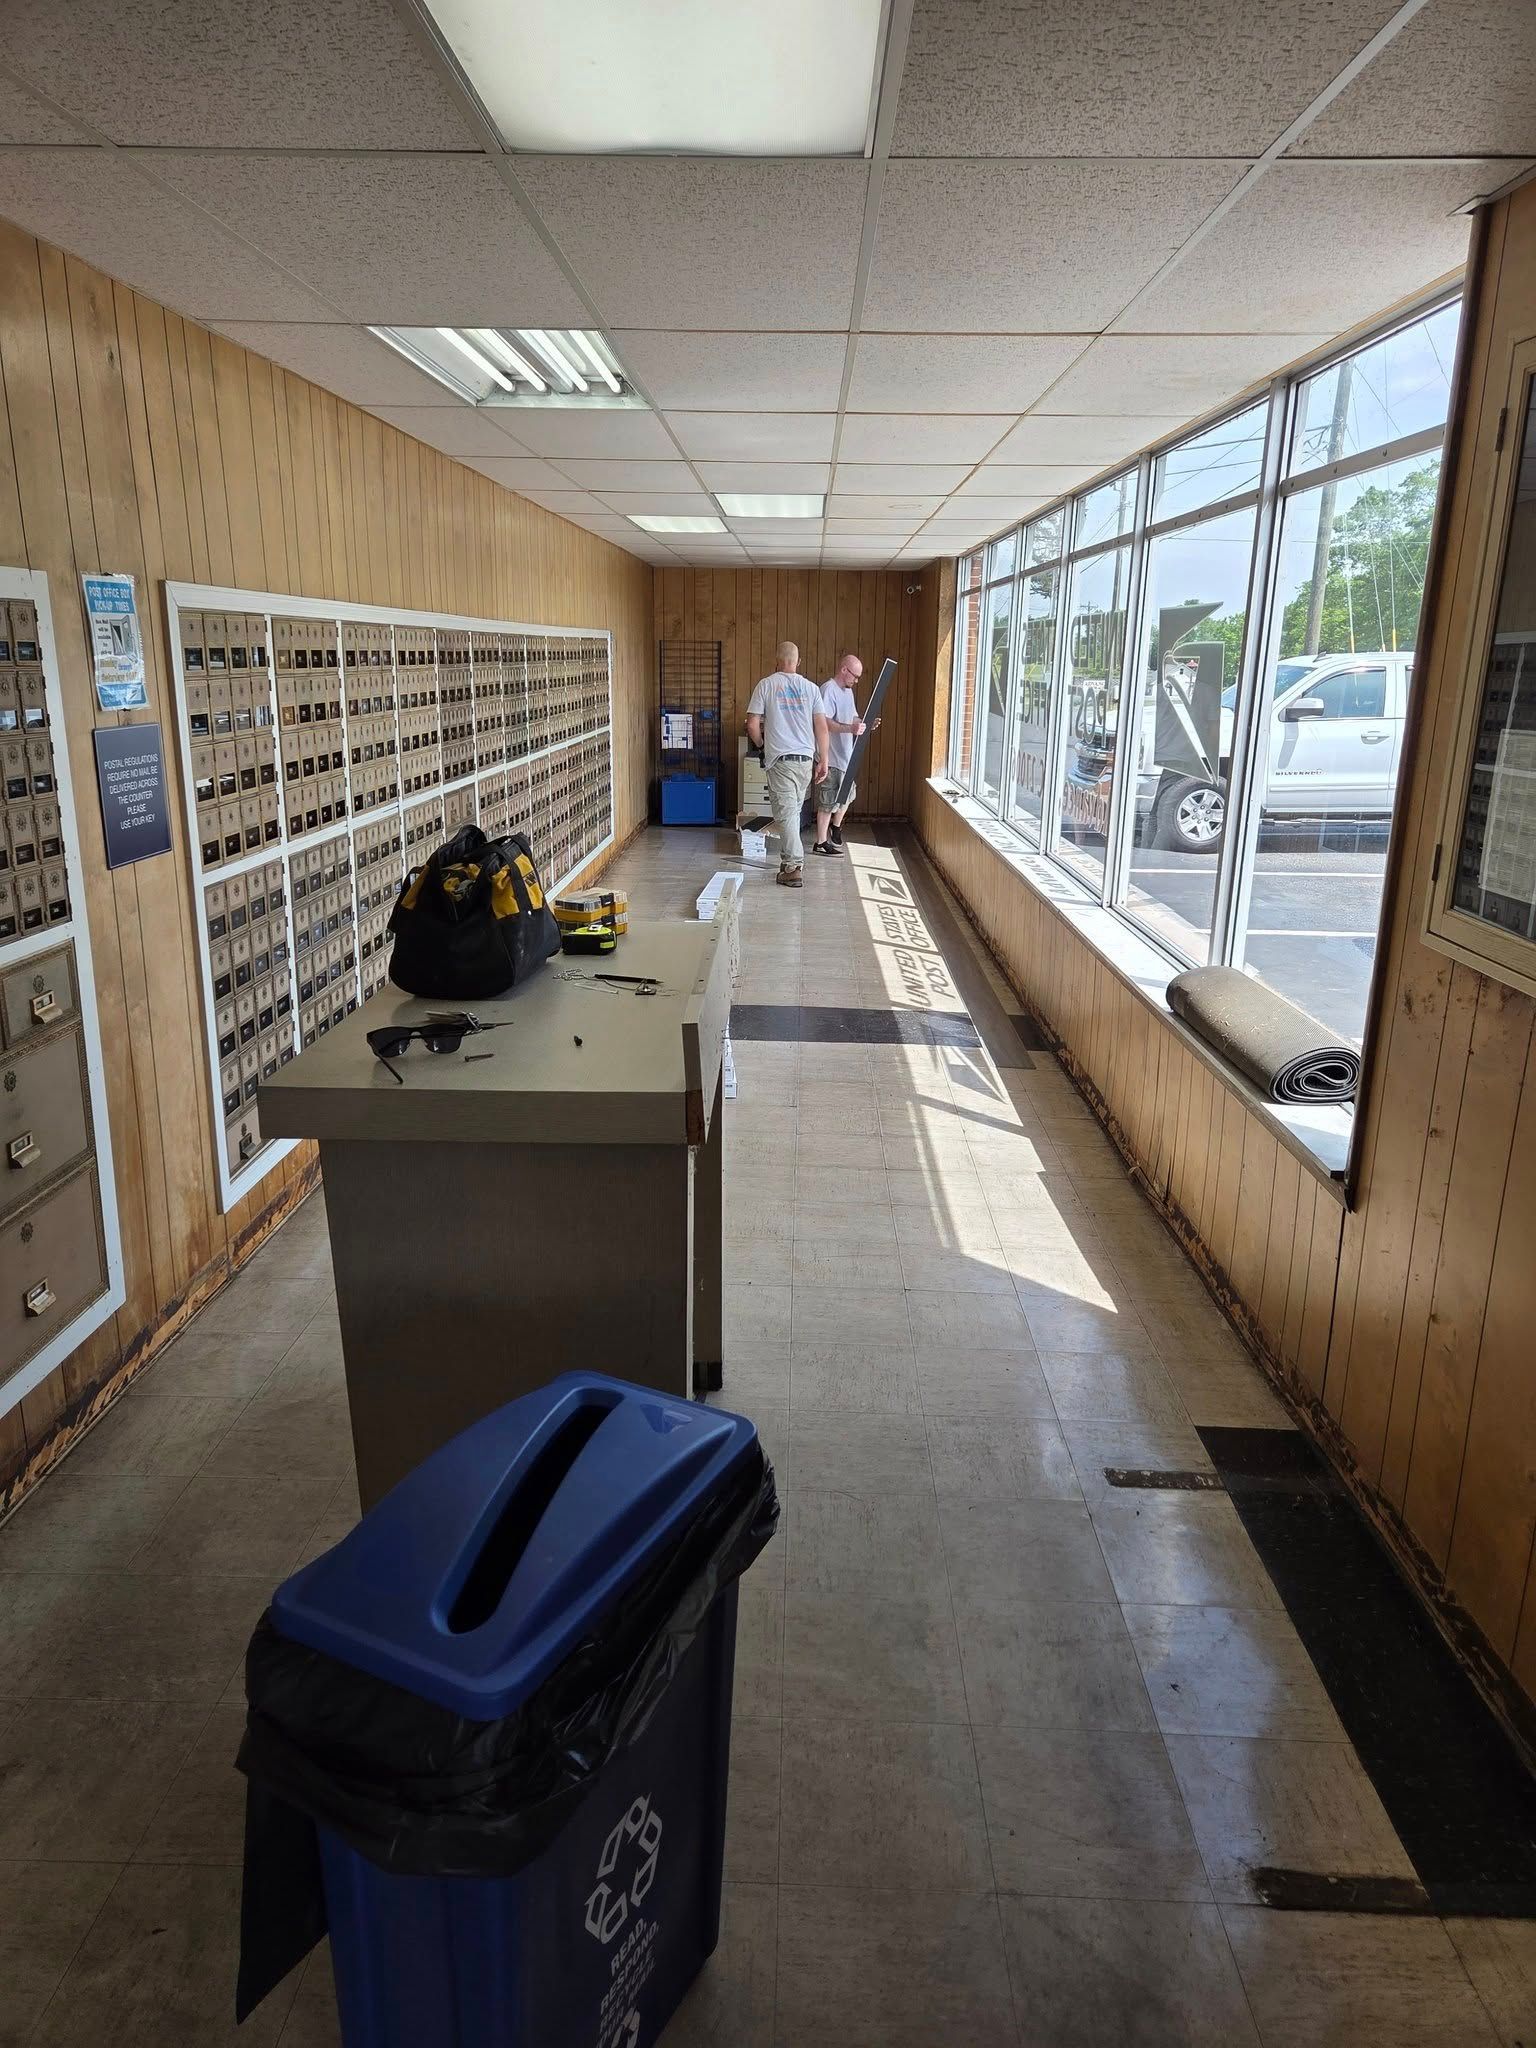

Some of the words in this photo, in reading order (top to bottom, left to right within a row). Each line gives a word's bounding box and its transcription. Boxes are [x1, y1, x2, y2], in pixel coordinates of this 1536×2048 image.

[88, 586, 102, 597] POST
[102, 587, 120, 598] OFFICE
[120, 588, 130, 599] BOX
[115, 601, 130, 612] TIMES
[104, 759, 124, 770] POSTAL
[124, 753, 159, 766] REGULATIONS
[107, 770, 130, 782] REQUIRE
[130, 768, 139, 778] NO
[139, 767, 151, 776] MAIL
[151, 765, 158, 775] BE
[109, 781, 138, 794] DELIVERED
[138, 777, 159, 788] ACROSS
[118, 795, 129, 805] THE
[129, 790, 153, 803] COUNTER
[127, 803, 147, 816] PLEASE
[120, 819, 131, 830] USE
[132, 816, 146, 826] YOUR
[146, 813, 155, 823] KEY
[876, 904, 907, 943] STATES
[898, 909, 931, 949] OFFICE
[892, 949, 933, 1008] UNITED
[917, 955, 957, 1000] POST
[610, 1918, 648, 1977] READ,
[601, 1920, 660, 2015] RESPOND,
[600, 1944, 656, 2034] RECYCLE
